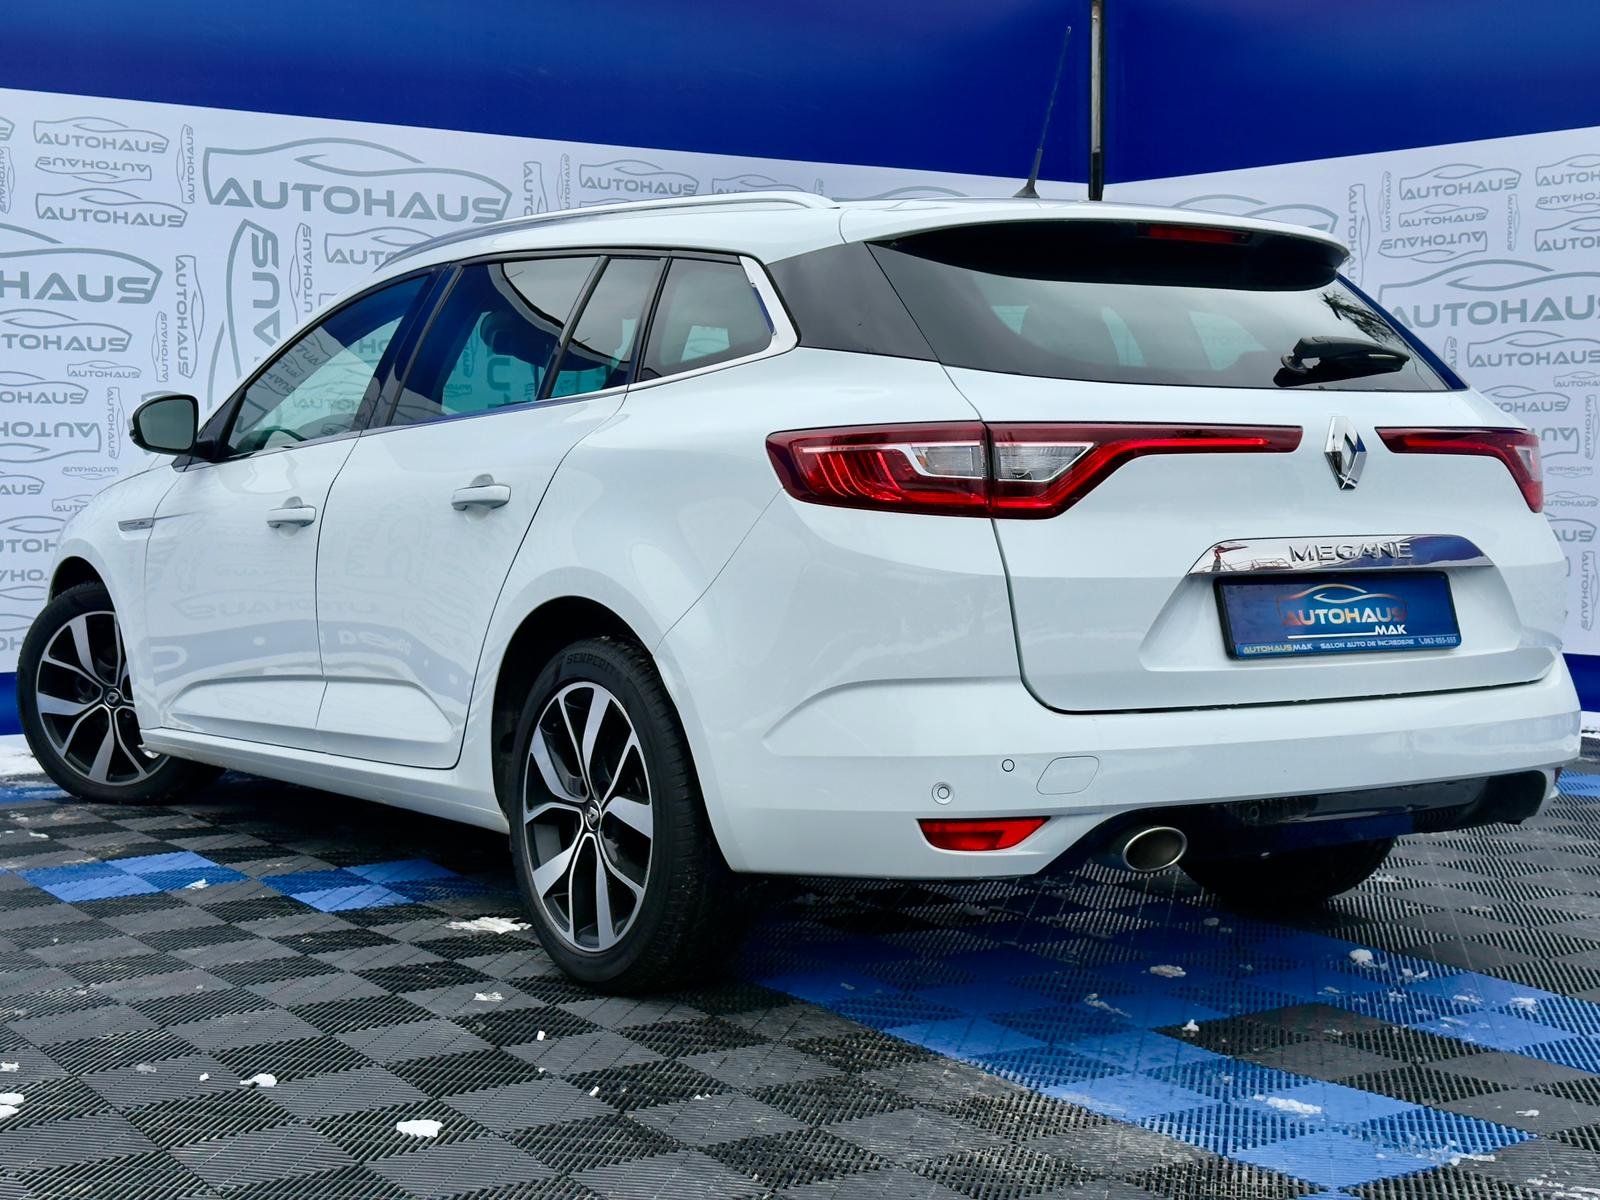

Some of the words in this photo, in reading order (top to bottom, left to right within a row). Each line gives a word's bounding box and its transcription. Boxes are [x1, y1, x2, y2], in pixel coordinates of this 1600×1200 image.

[38, 132, 167, 153] AUTOHAUS
[38, 156, 150, 172] AUTOHAUS
[185, 125, 195, 202] AUTOHAUS
[583, 176, 696, 195] AUTOHAUS
[1402, 178, 1518, 200] AUTOHAUS
[209, 177, 503, 223] AUTOHAUS
[40, 206, 184, 227] AUTOHAUS
[1401, 211, 1487, 227] AUTOHAUS
[1381, 231, 1485, 249] AUTOHAUS
[1539, 236, 1600, 252] AUTO
[176, 259, 189, 376] AUTOHAUS
[1392, 294, 1600, 328] AUTOHAU
[160, 313, 168, 381] AUTOHAUS
[70, 370, 140, 378] AUTOHAUS
[107, 388, 115, 457] AUTOHAUS
[1289, 542, 1414, 562] MEGANE
[1581, 554, 1589, 629] AUTOHAUS
[1283, 606, 1407, 626] AUTOHAUS
[1375, 624, 1407, 635] MAK
[1347, 640, 1366, 648] AUTO
